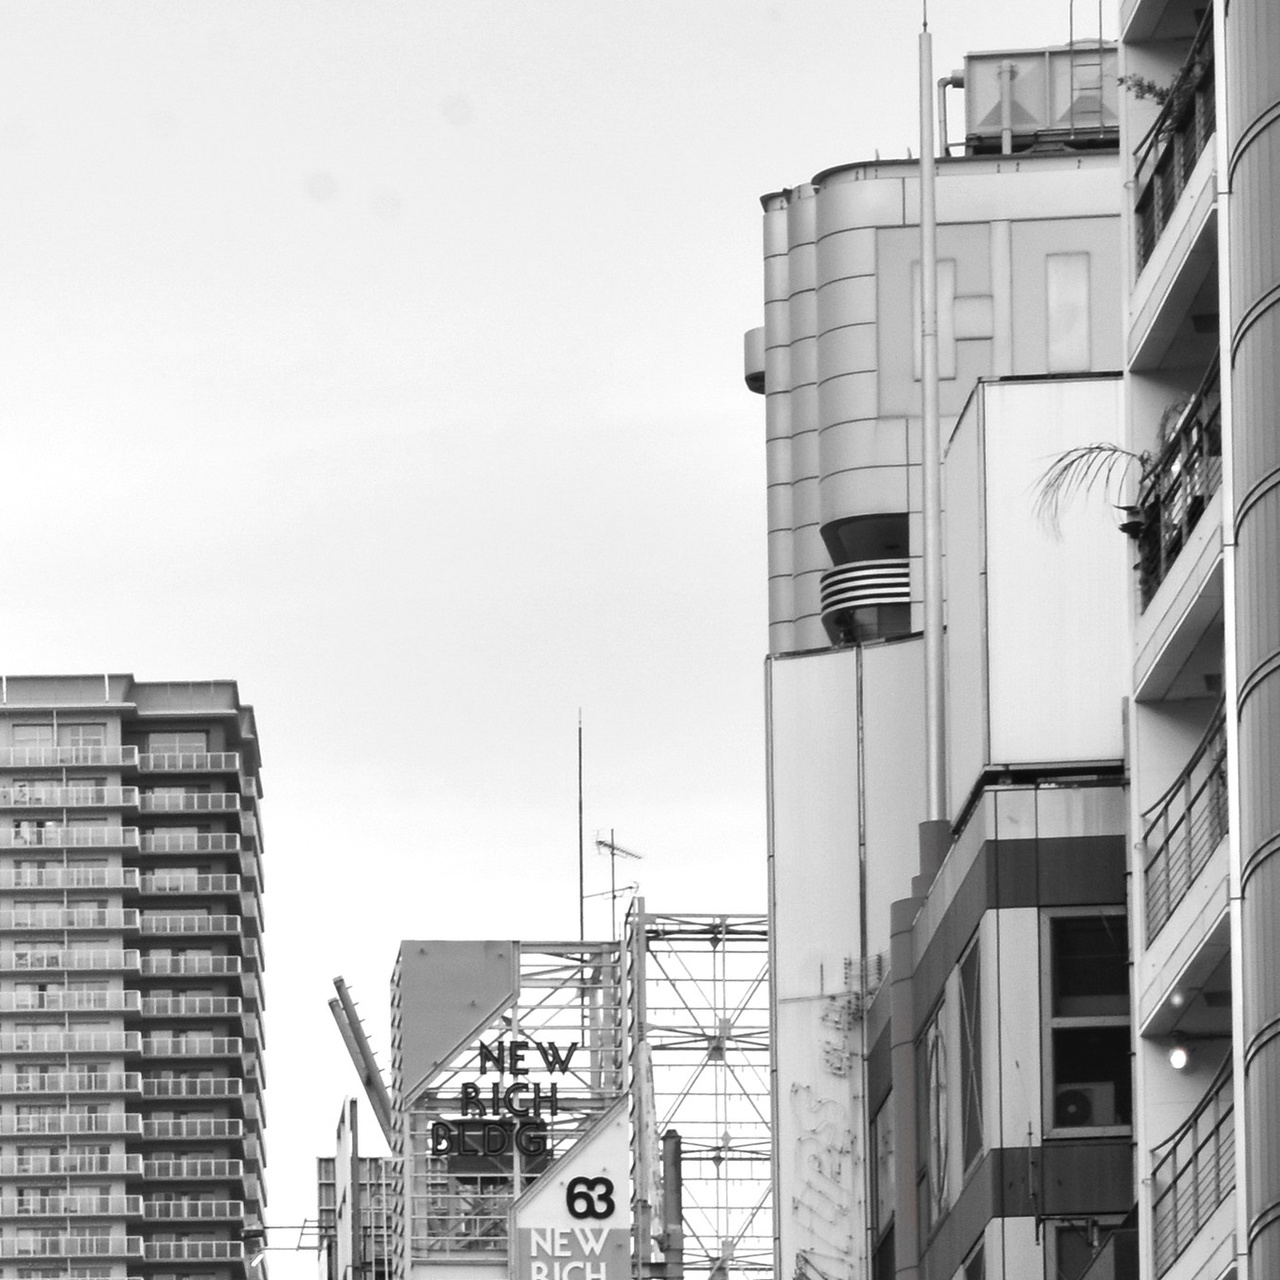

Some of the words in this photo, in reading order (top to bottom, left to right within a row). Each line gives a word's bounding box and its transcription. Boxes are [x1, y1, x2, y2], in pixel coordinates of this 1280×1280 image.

[479, 1040, 579, 1075] NEW
[460, 1082, 559, 1117] RICH
[566, 1176, 615, 1220] 63
[530, 1228, 611, 1257] NEW
